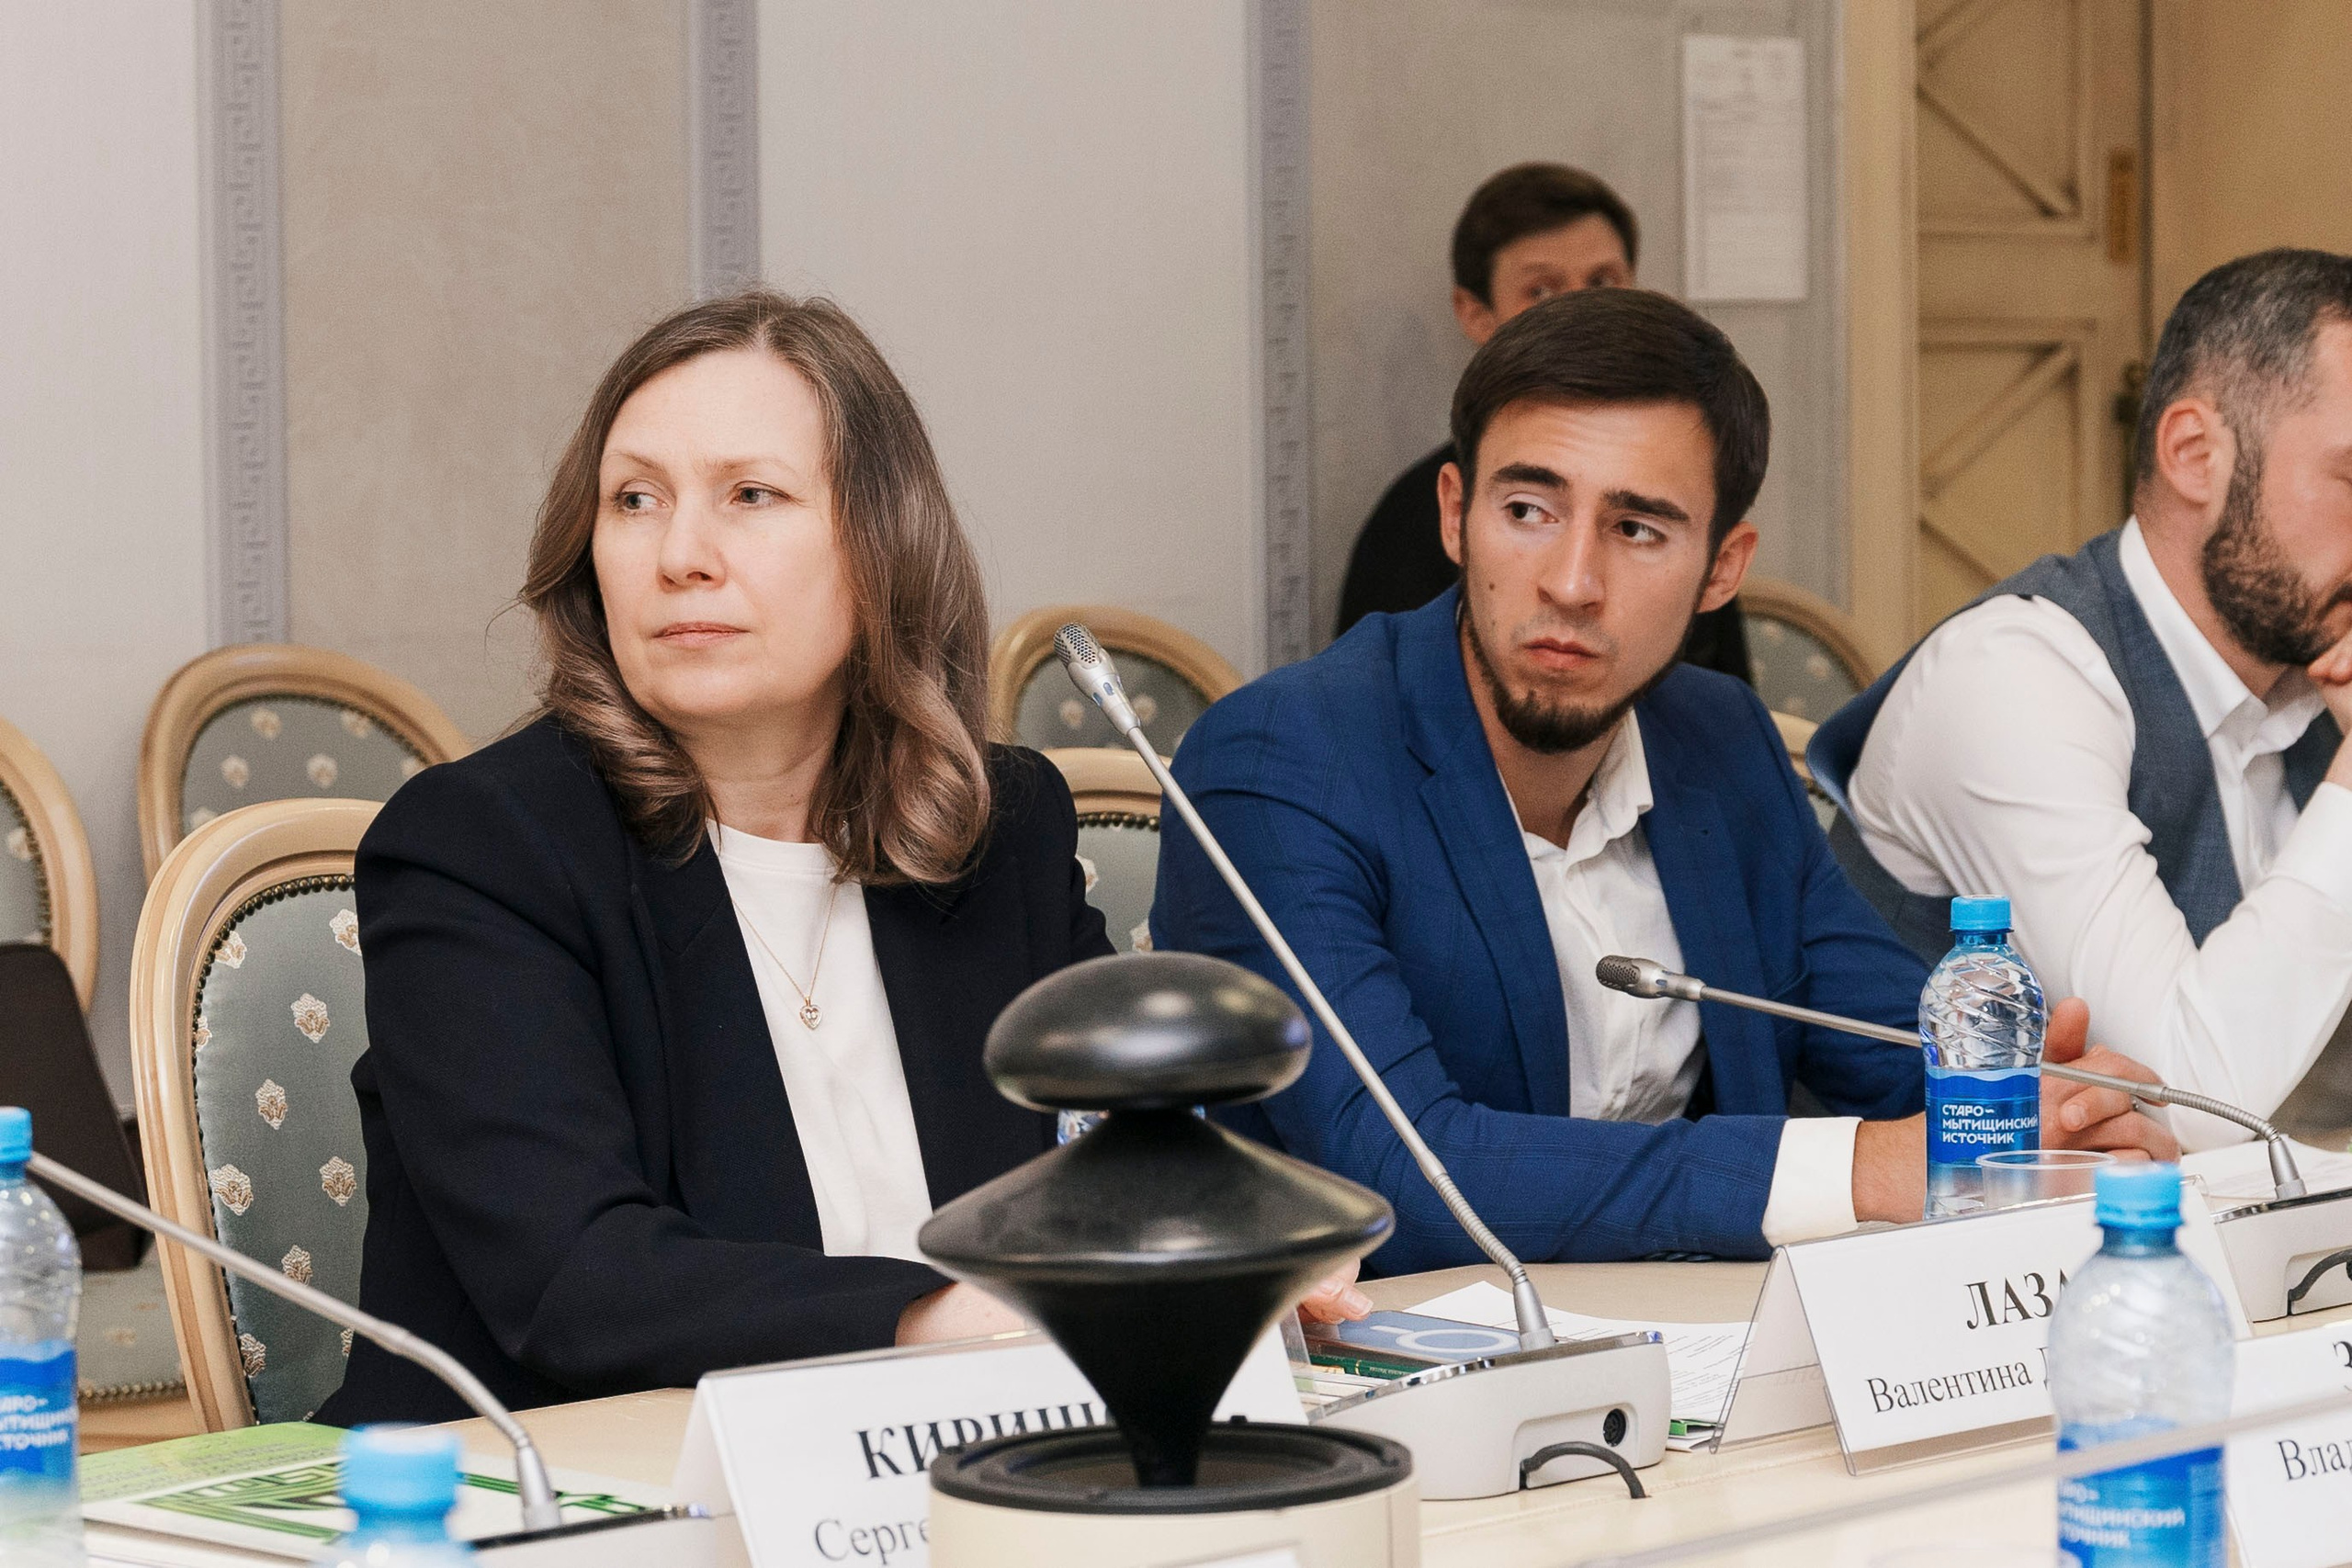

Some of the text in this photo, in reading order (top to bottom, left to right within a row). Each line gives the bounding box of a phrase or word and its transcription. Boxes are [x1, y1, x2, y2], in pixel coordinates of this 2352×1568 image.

[1941, 1104, 1995, 1117] СТАРО-
[1941, 1114, 2039, 1132] МЫТИЩИНСКИЙ
[1941, 1132, 2015, 1145] ИСТОЧНИК
[1866, 1361, 2033, 1414] Валентина
[814, 1517, 929, 1565] Серге
